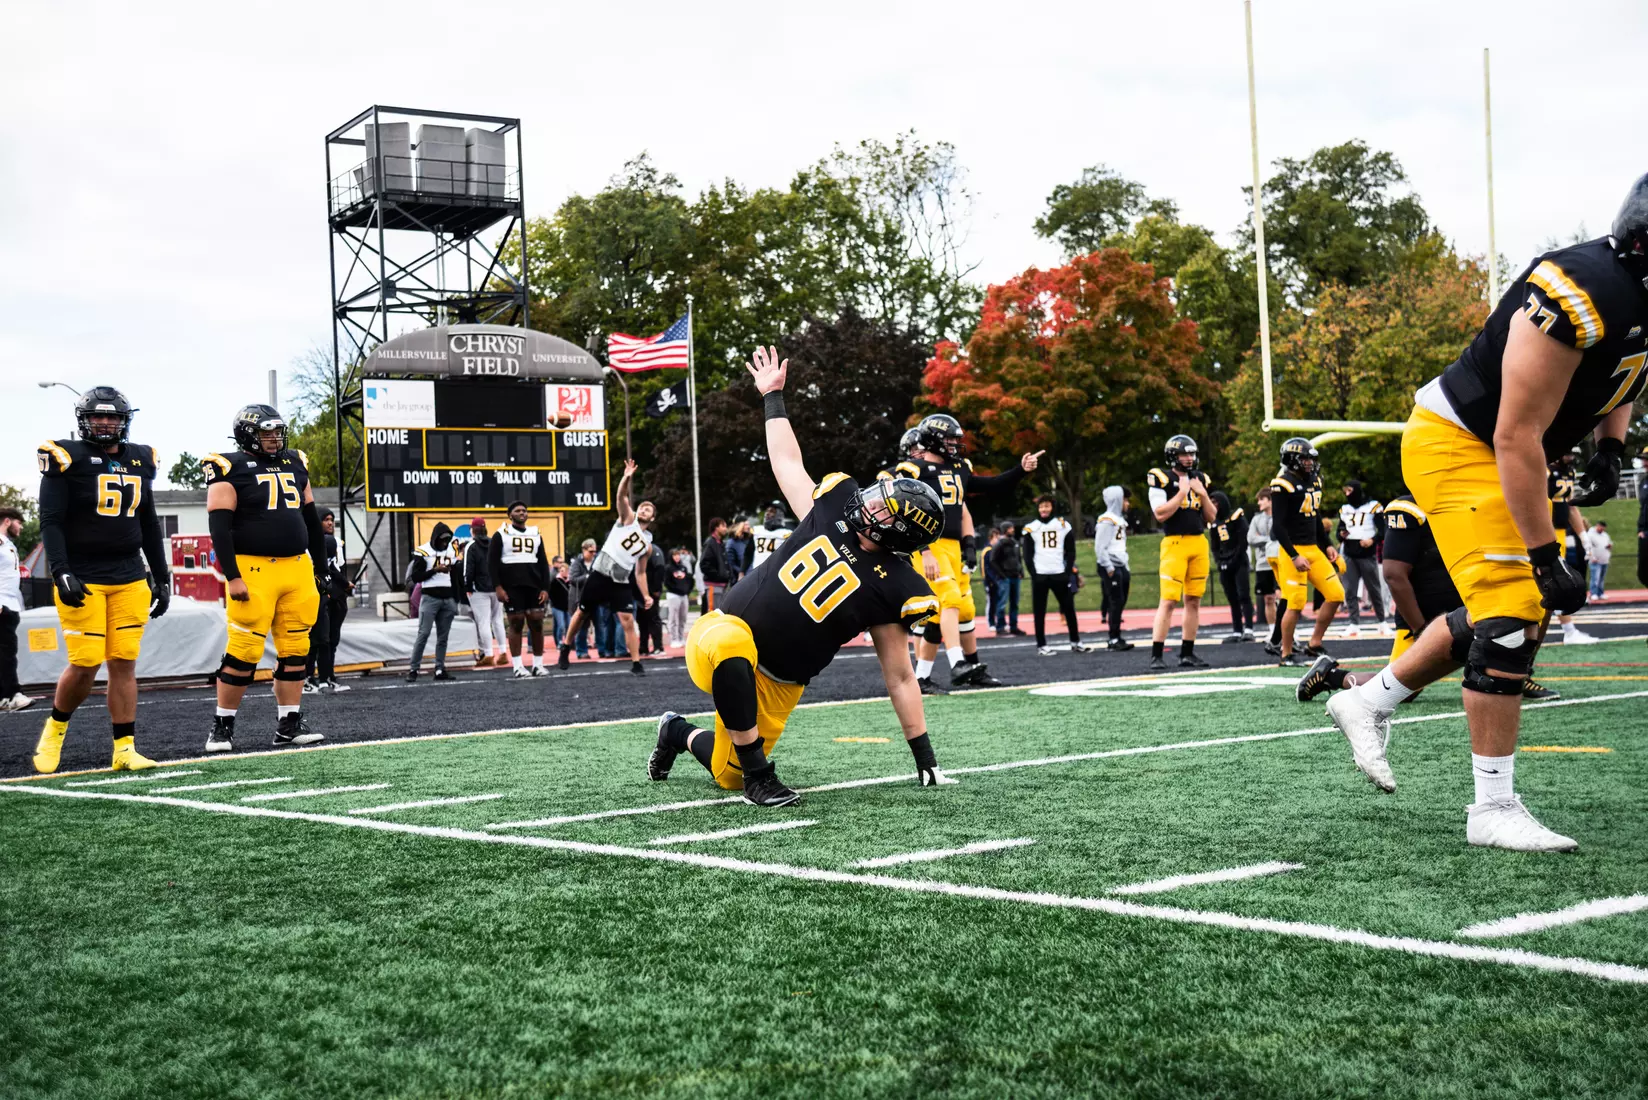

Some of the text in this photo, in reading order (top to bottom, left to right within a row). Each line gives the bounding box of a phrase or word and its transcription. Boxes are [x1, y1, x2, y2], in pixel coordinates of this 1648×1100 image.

[1526, 292, 1559, 334] 77
[450, 335, 525, 356] CHRYST
[377, 350, 448, 361] MILLERSVILLE
[532, 353, 589, 364] UNIVERSITY
[462, 356, 520, 377] FIELD
[382, 400, 397, 410] the
[409, 403, 434, 413] group
[925, 420, 950, 432] VILLE
[367, 429, 409, 445] HOME
[563, 431, 605, 447] GUEST
[403, 471, 570, 484] DOWN TO GO BALL ON QTR
[97, 473, 142, 518] 67
[255, 472, 300, 510] 75
[938, 474, 964, 506] 51
[374, 493, 405, 507] T.O.L.
[575, 493, 604, 506] T.O.L.
[903, 500, 940, 536] VILLE
[512, 537, 535, 554] 99
[621, 532, 646, 557] 87
[757, 537, 776, 553] 84
[1042, 530, 1058, 549] 18
[839, 544, 858, 565] VILLE
[778, 534, 861, 624] 60
